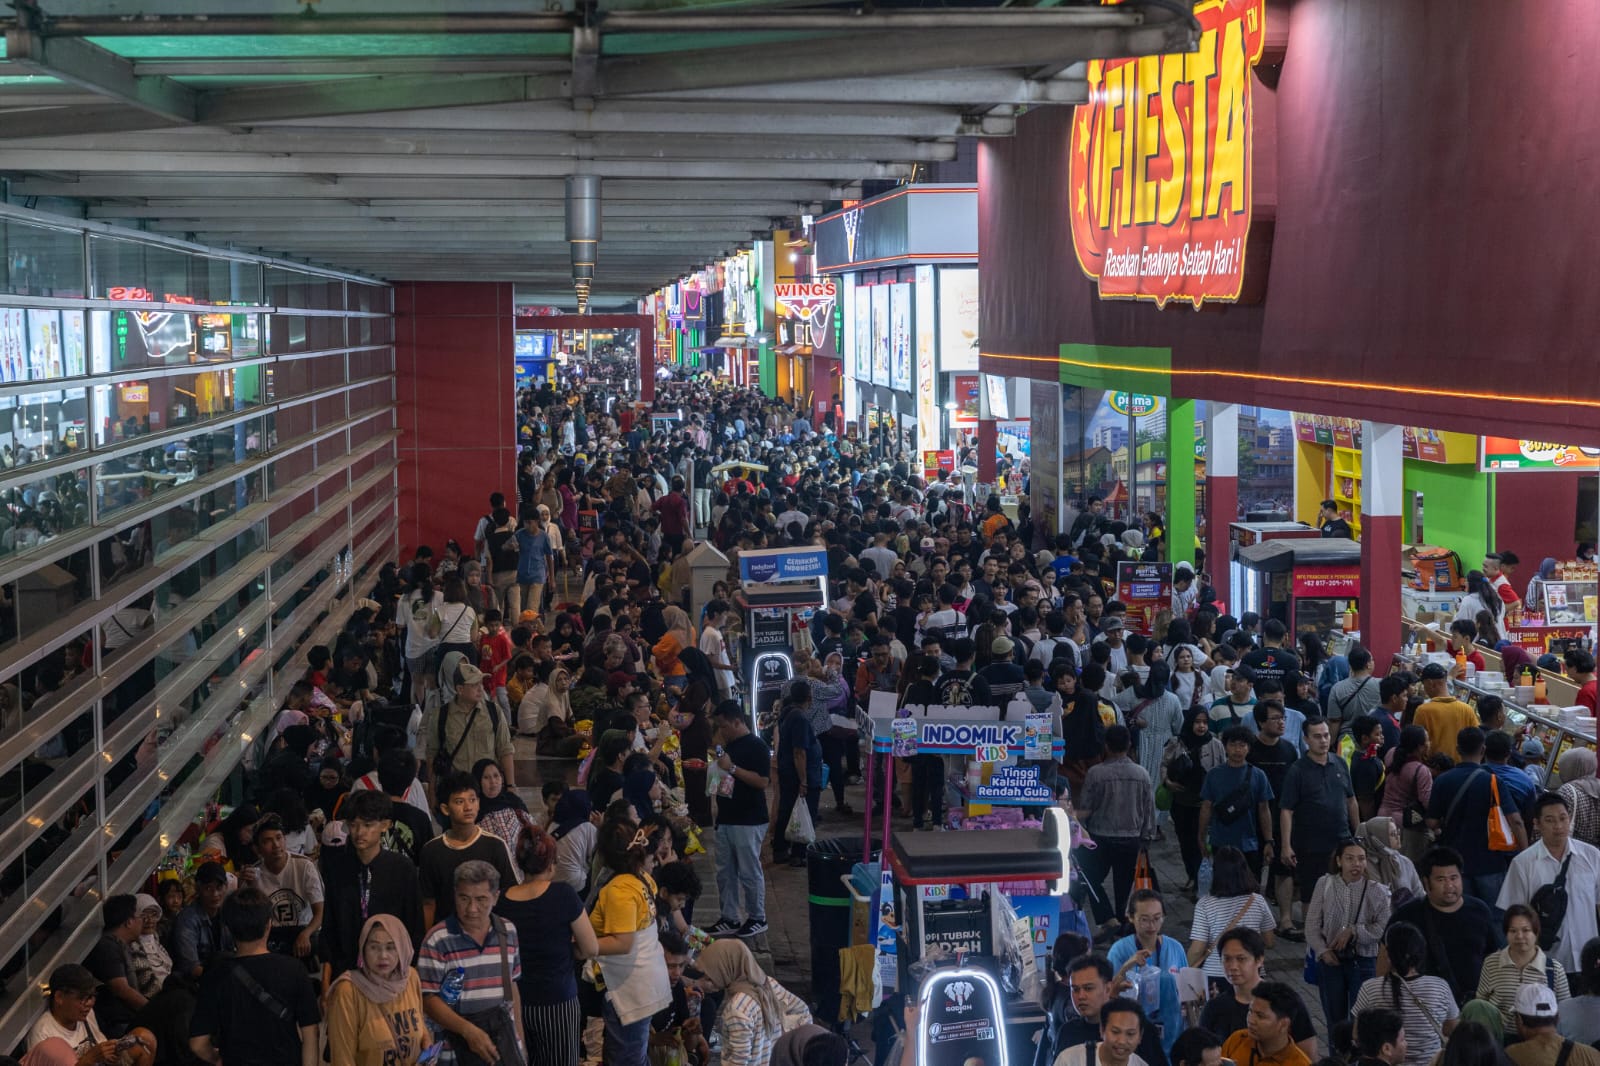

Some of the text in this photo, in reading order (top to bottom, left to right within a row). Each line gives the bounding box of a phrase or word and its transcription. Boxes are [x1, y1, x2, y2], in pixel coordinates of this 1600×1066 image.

[1099, 17, 1246, 229] FIESTA
[1104, 248, 1139, 277] Rasakan
[1139, 245, 1179, 285] Enaknya
[1179, 242, 1208, 285] Setiap
[1211, 237, 1235, 275] Hari
[774, 283, 836, 297] WINGS
[923, 725, 1017, 745] INDOMILK
[1003, 767, 1038, 780] Tinggi
[991, 777, 1037, 787] Kalsium
[978, 786, 1050, 797] Rendah Gula
[943, 931, 981, 940] TUBRUK
[925, 941, 982, 953] ADJAH
